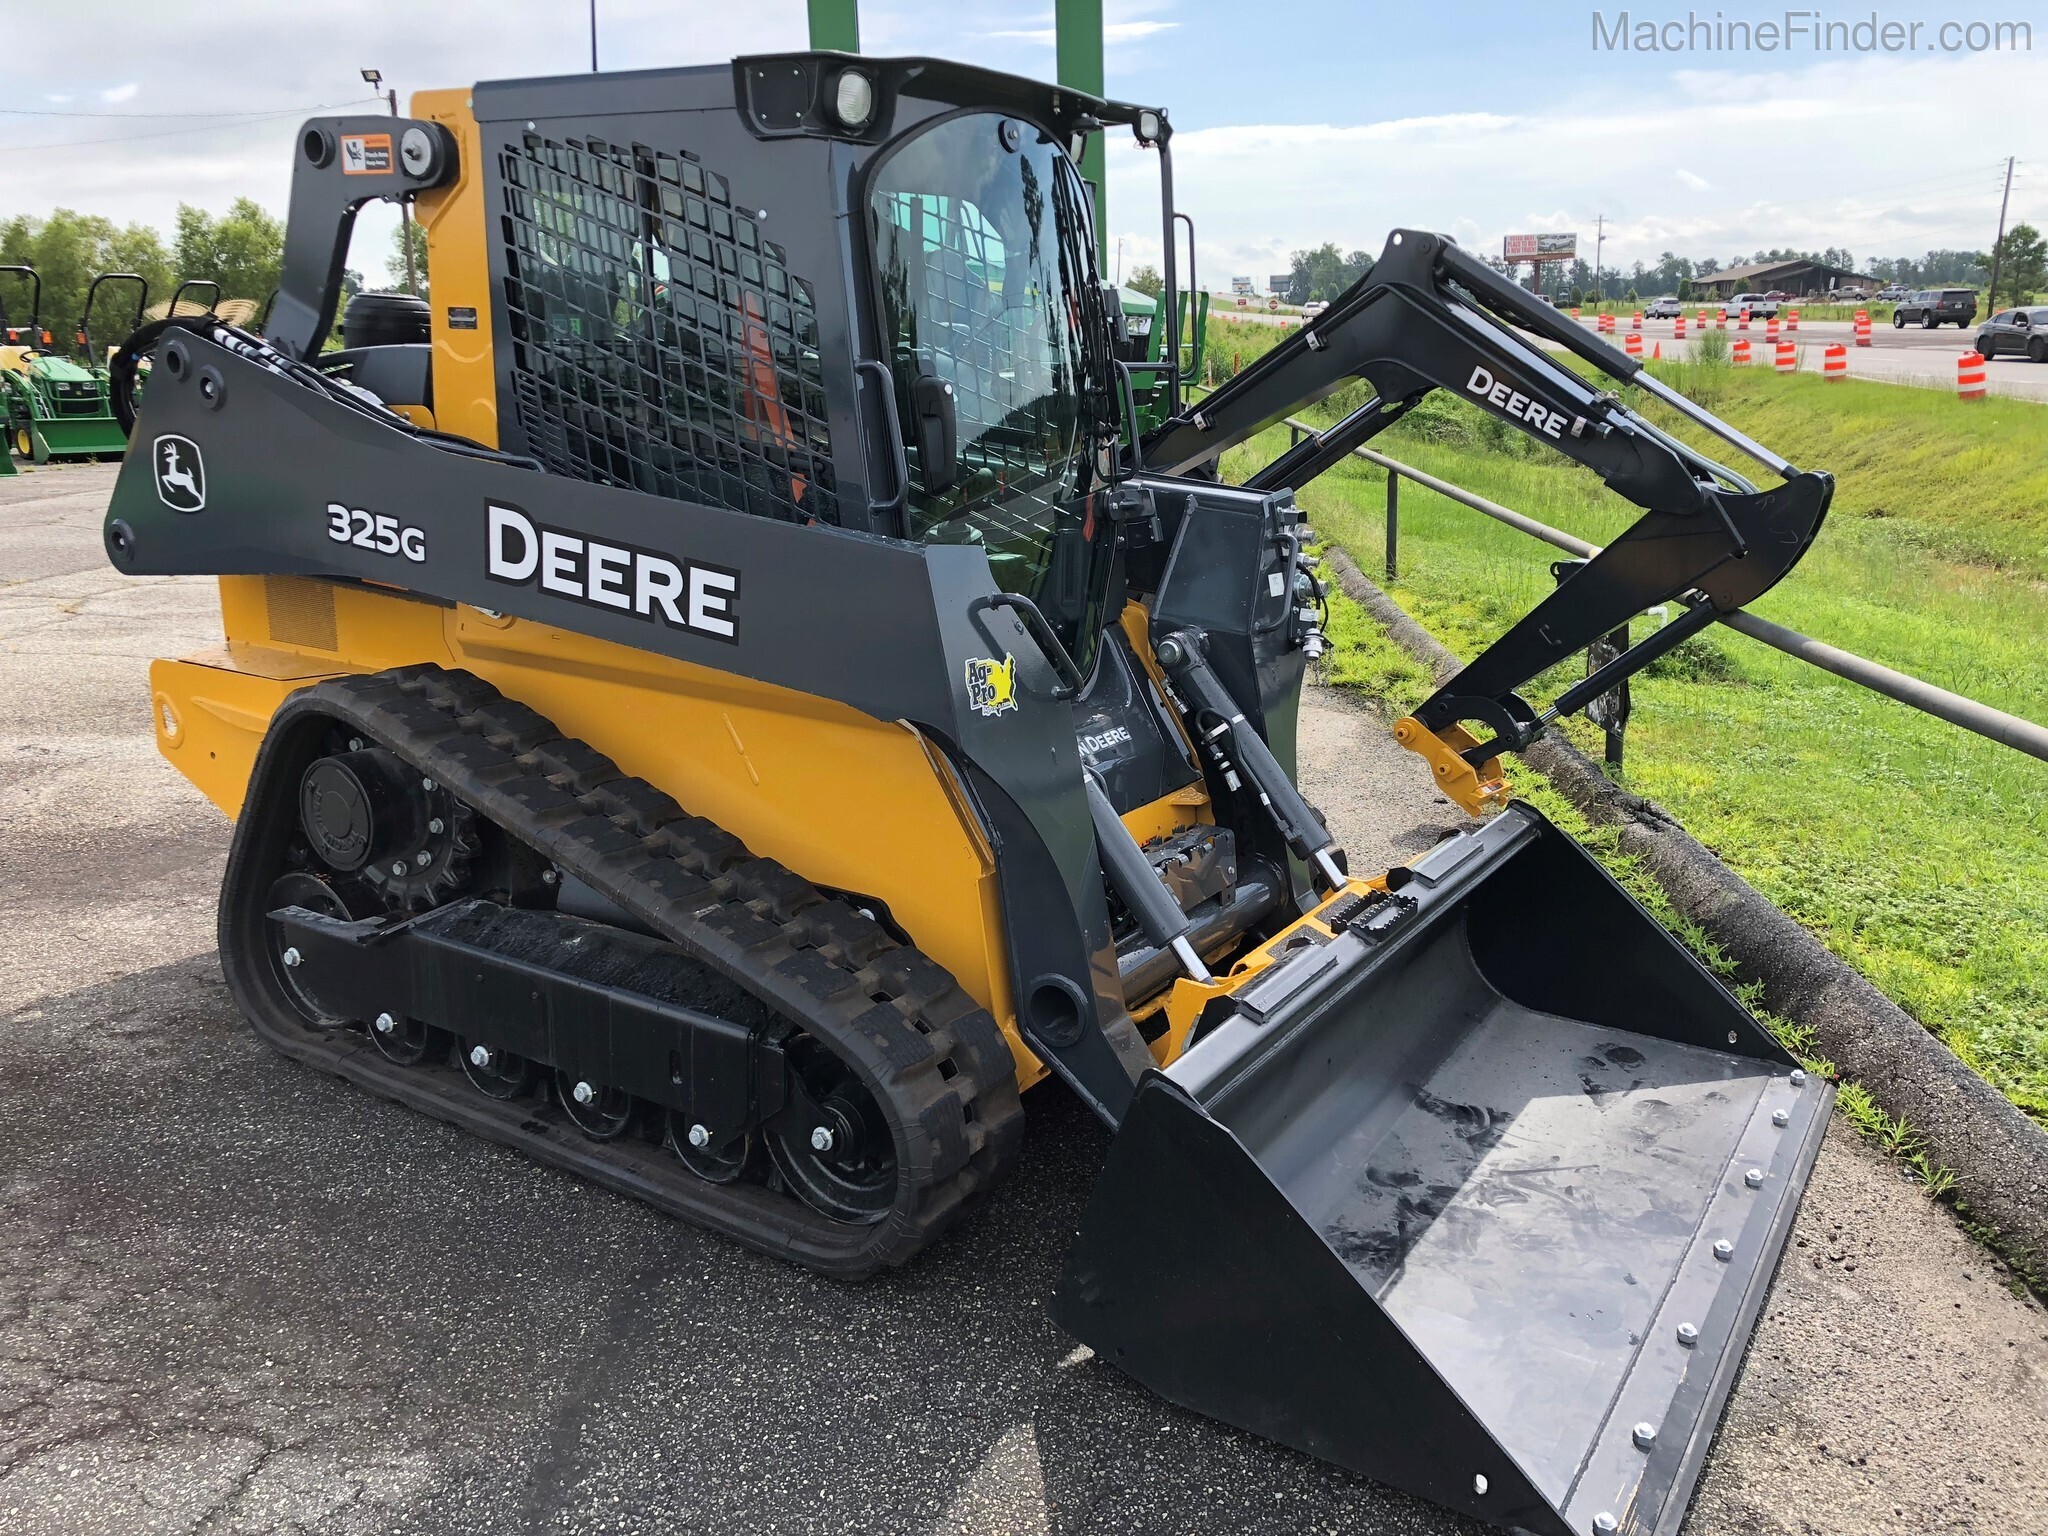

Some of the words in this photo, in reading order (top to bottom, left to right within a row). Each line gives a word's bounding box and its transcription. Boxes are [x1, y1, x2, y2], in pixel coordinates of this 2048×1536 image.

[1466, 365, 1568, 440] DEERE
[326, 503, 426, 562] 325G
[488, 504, 737, 638] DEERE
[968, 661, 992, 686] Ag-
[970, 683, 997, 706] Pro
[1084, 726, 1132, 752] DEERE
